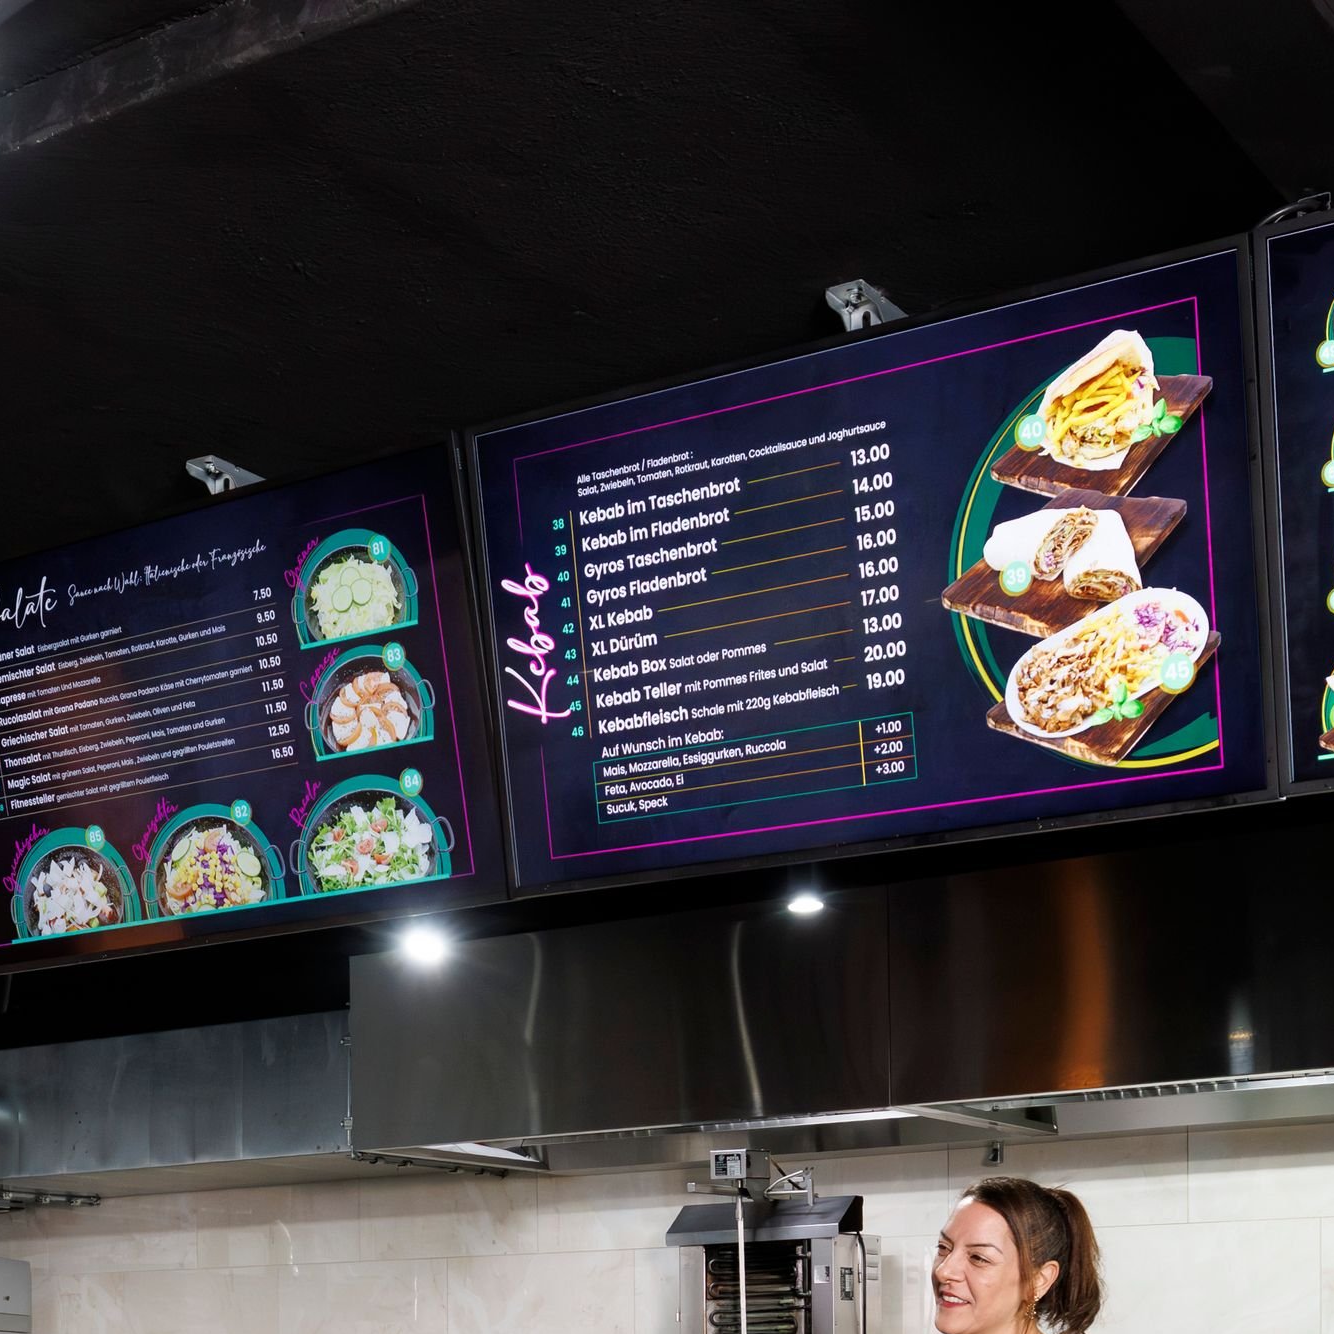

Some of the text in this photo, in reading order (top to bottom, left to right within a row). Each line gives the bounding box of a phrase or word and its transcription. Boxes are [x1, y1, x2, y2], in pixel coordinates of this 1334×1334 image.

[552, 443, 890, 531] 38 Kebab im Taschenbrot 13.00
[554, 471, 893, 557] 39 Kebab im Fladenbrot 14.00
[557, 500, 895, 583] 40 Gyros Taschenbrot 15.00
[560, 528, 897, 608] 41 Gyros Fladenbrot 16.00
[252, 586, 272, 601] 7.50
[562, 556, 899, 634] 42 XL Kebab 16.00
[256, 609, 276, 624] 9.50
[564, 584, 900, 660] 43 XL Dürüm 17.00
[255, 632, 278, 647] 10.50
[501, 563, 571, 724] Kebab
[566, 612, 903, 686] 44 Kebab Box Salat oder Pommes 13.00
[14, 644, 36, 658] Salat
[35, 661, 56, 675] Salat
[258, 655, 281, 670] 10.50
[595, 640, 907, 709] Kebab Teller mit Pommes Frites und Salat 20.00
[261, 678, 284, 693] 11.50
[264, 700, 288, 715] 11.50
[571, 668, 906, 737] 46 Kebabfleisch Schale mit 220g Kebabfleisch 19.00
[0, 724, 69, 748] Griechischer Salat
[267, 723, 290, 737] 12.50
[271, 745, 294, 760] 16.50
[601, 727, 725, 759] Auf Wunsch im Kebab:
[3, 752, 42, 768] Thonsalat
[7, 772, 52, 790] Magic Salat
